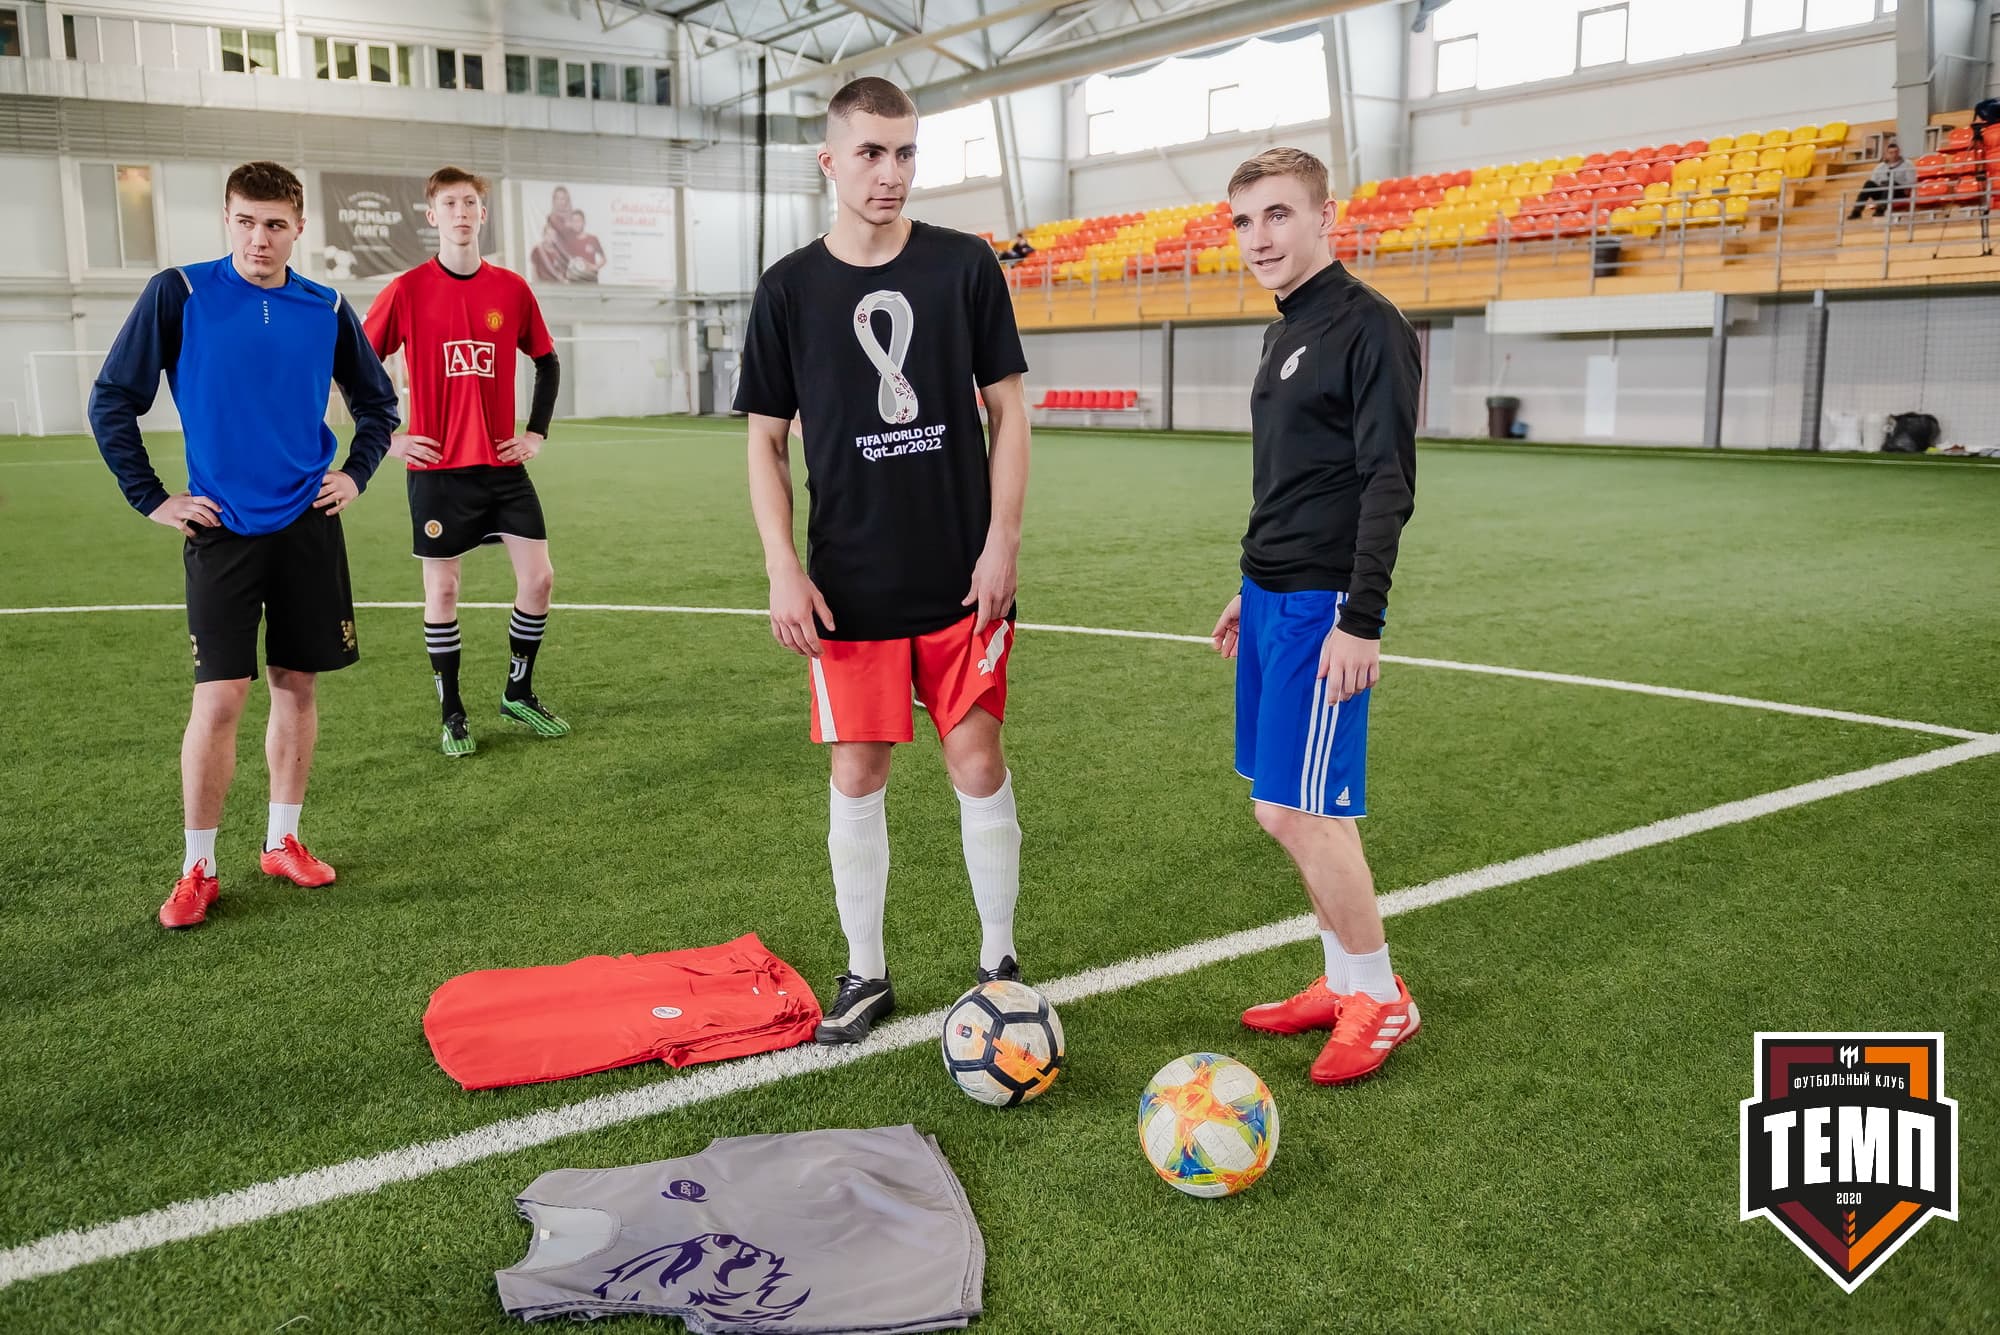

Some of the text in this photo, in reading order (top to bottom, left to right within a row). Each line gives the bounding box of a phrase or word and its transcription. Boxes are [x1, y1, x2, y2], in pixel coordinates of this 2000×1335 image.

[338, 209, 403, 225] ПРЕМЬЕР
[353, 223, 390, 240] ЛИГА
[450, 344, 492, 373] AIG
[855, 424, 946, 448] FIFA WORLD CUP
